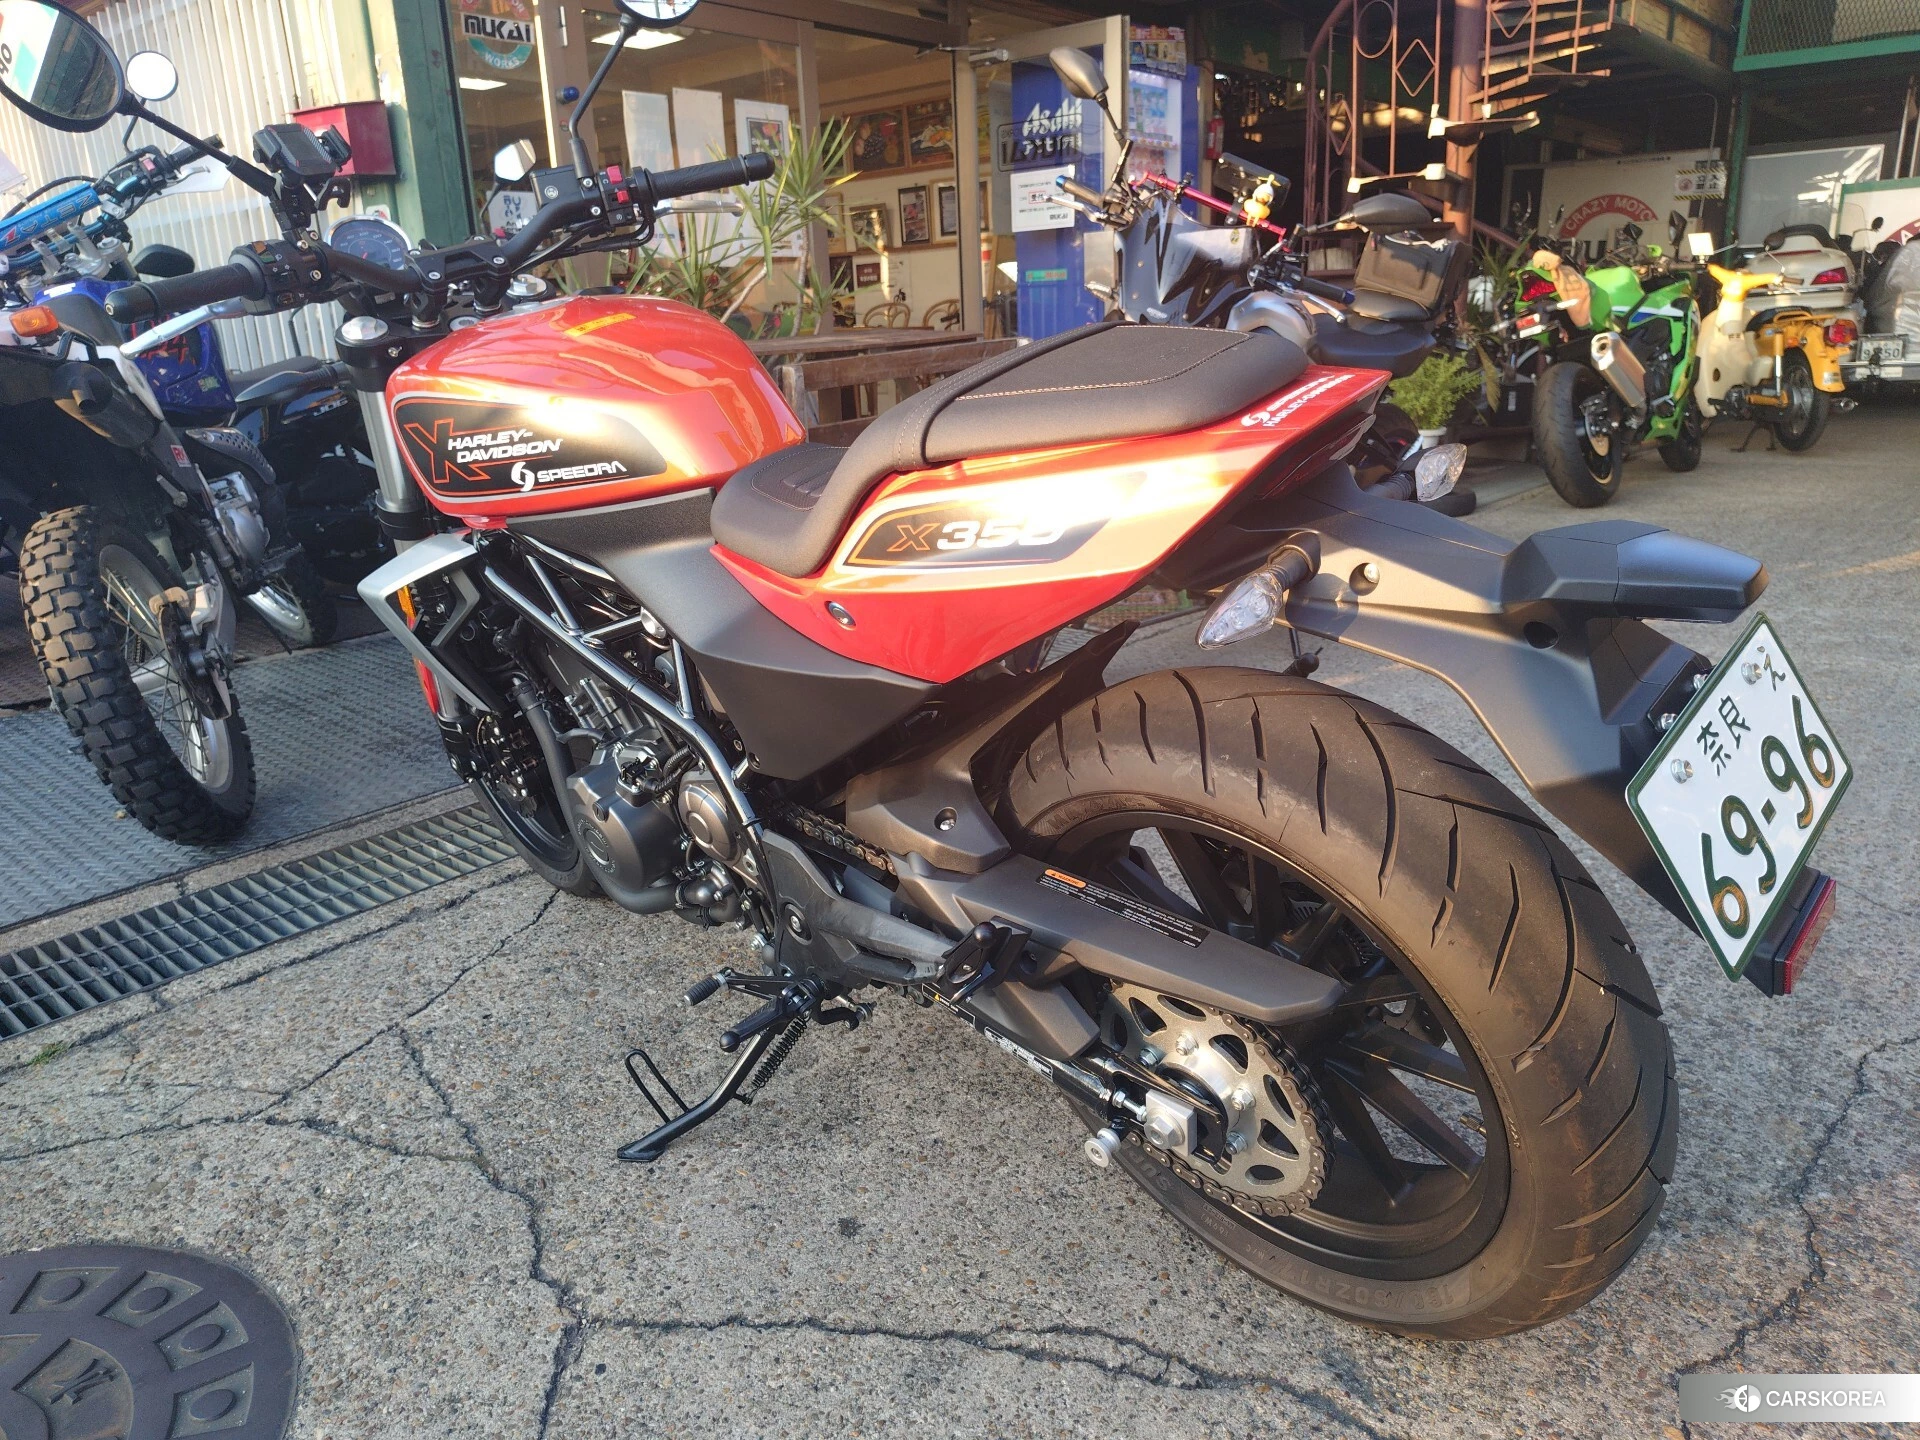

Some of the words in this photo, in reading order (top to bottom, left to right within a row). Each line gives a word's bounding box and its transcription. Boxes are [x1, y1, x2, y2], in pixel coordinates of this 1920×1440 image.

[464, 14, 531, 42] MUKAI
[484, 51, 520, 69] WORKS
[1022, 97, 1082, 137] Asahi
[1565, 197, 1611, 231] CRAZY
[447, 429, 534, 451] HARLEY-
[456, 438, 564, 464] DAVIDSON
[536, 461, 628, 484] SPEEDRA
[1696, 695, 1751, 777] 奈良
